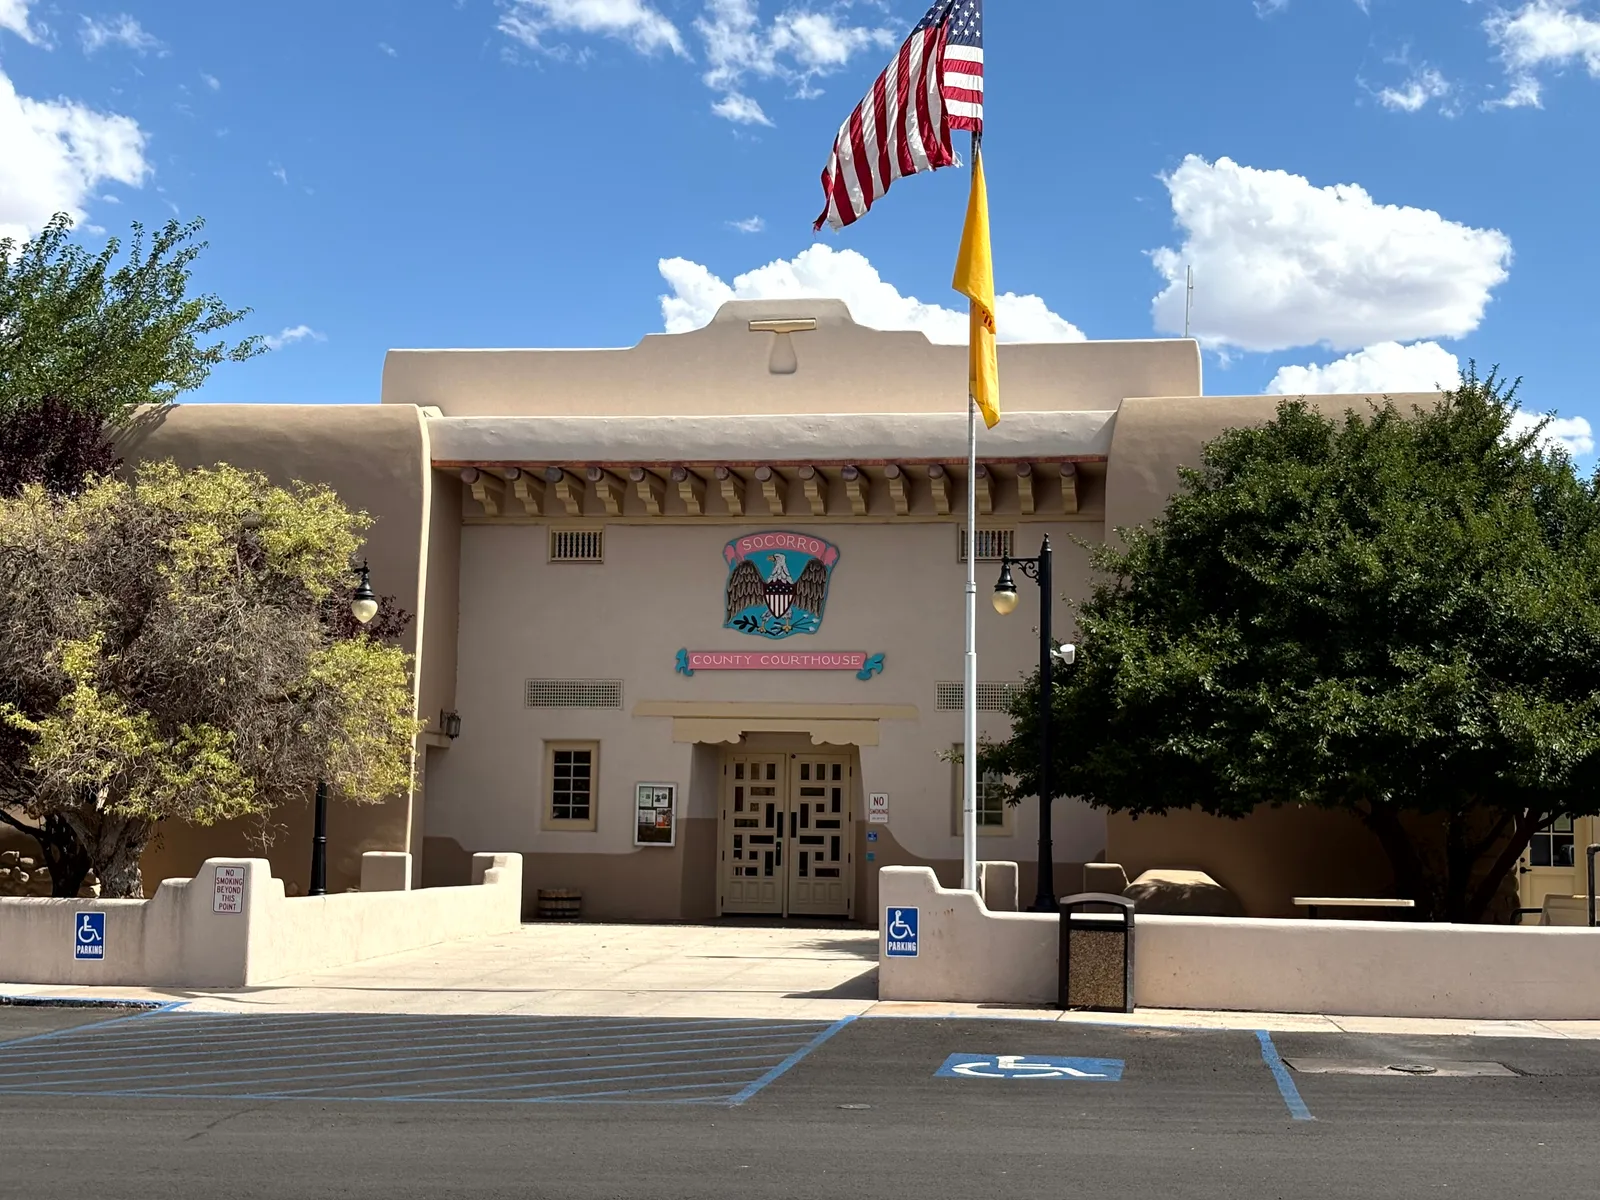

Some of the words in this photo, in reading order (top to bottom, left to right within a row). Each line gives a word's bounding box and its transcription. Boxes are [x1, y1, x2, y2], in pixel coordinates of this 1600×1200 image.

[742, 534, 820, 553] SOCORRO
[692, 655, 752, 666] COUNTY
[760, 655, 861, 666] COURTHOUSE
[873, 796, 885, 806] NO
[225, 869, 235, 877] NO
[216, 877, 243, 886] SMOKING
[216, 885, 241, 894] BEYOND
[221, 894, 236, 902] THIS
[218, 902, 237, 911] POINT
[76, 945, 103, 955] PARKING
[888, 941, 917, 952] PARKING
